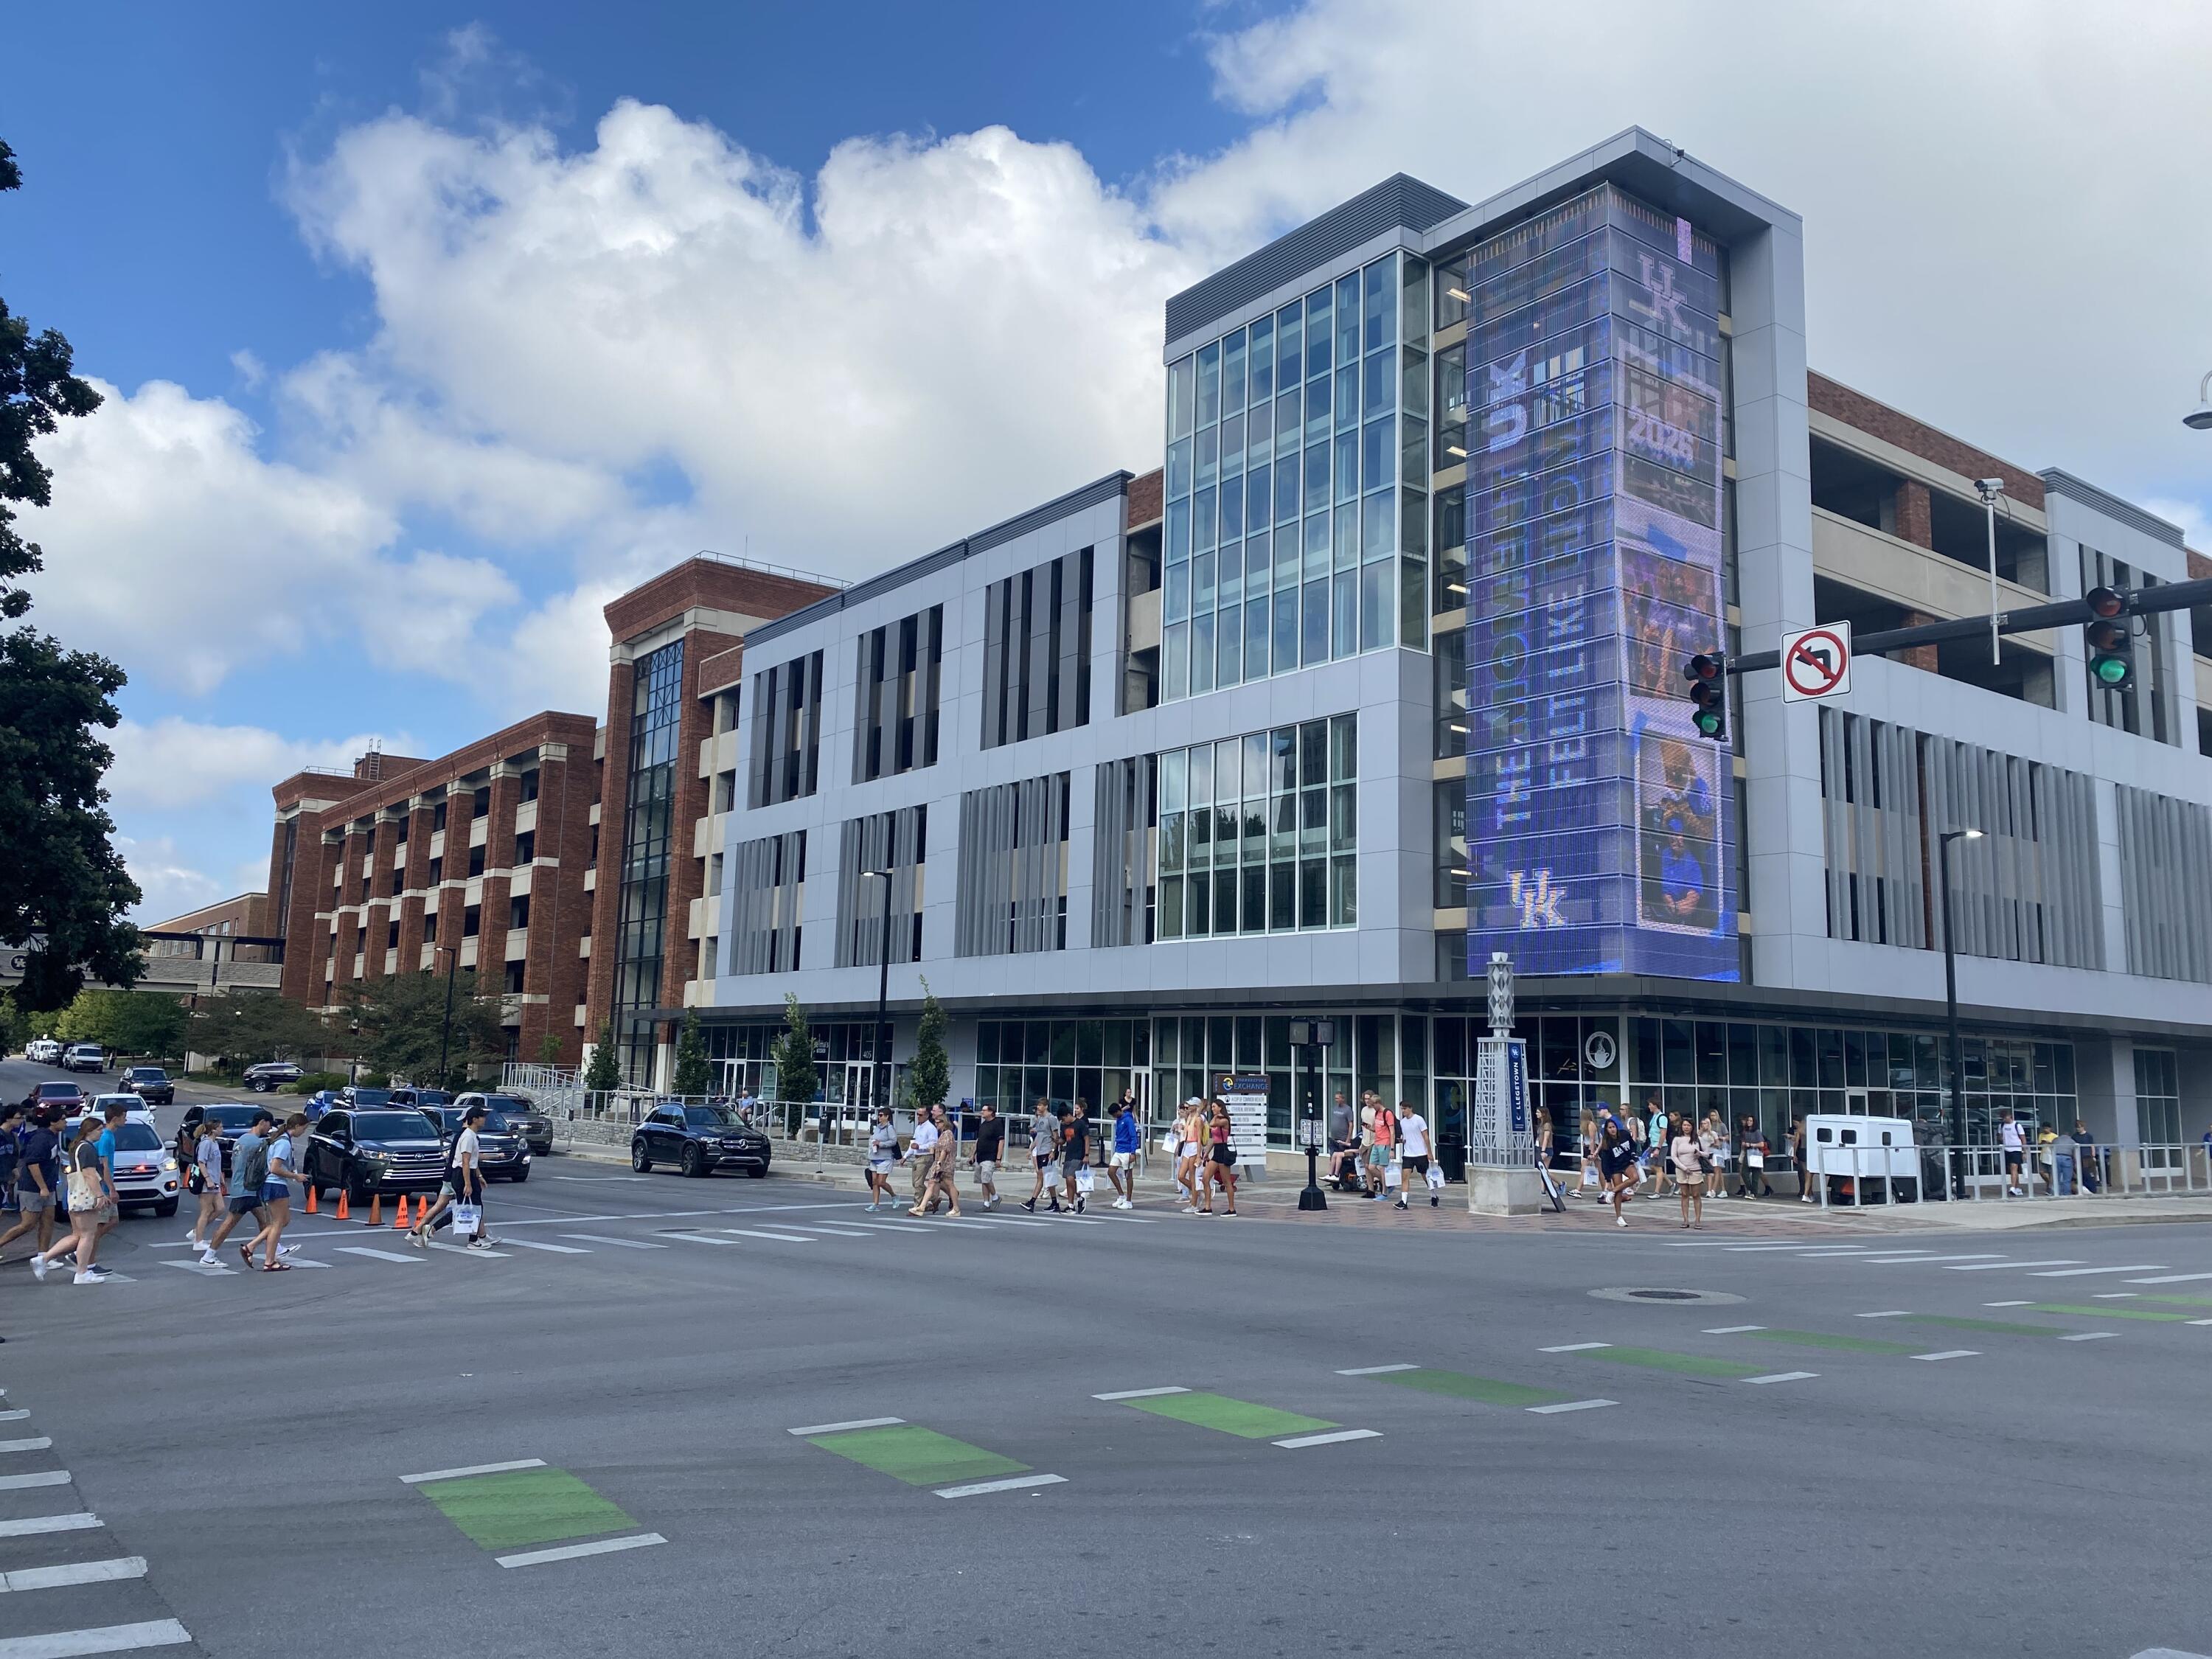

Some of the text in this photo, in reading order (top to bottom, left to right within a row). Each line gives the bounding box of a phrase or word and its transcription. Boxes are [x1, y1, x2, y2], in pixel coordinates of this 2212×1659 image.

[1638, 250, 1688, 333] UK
[1490, 349, 1531, 830] THE MOMENT UK
[1543, 416, 1586, 790] FELT LIKE HOM
[1507, 868, 1568, 931] UK
[863, 1051, 872, 1059] 405
